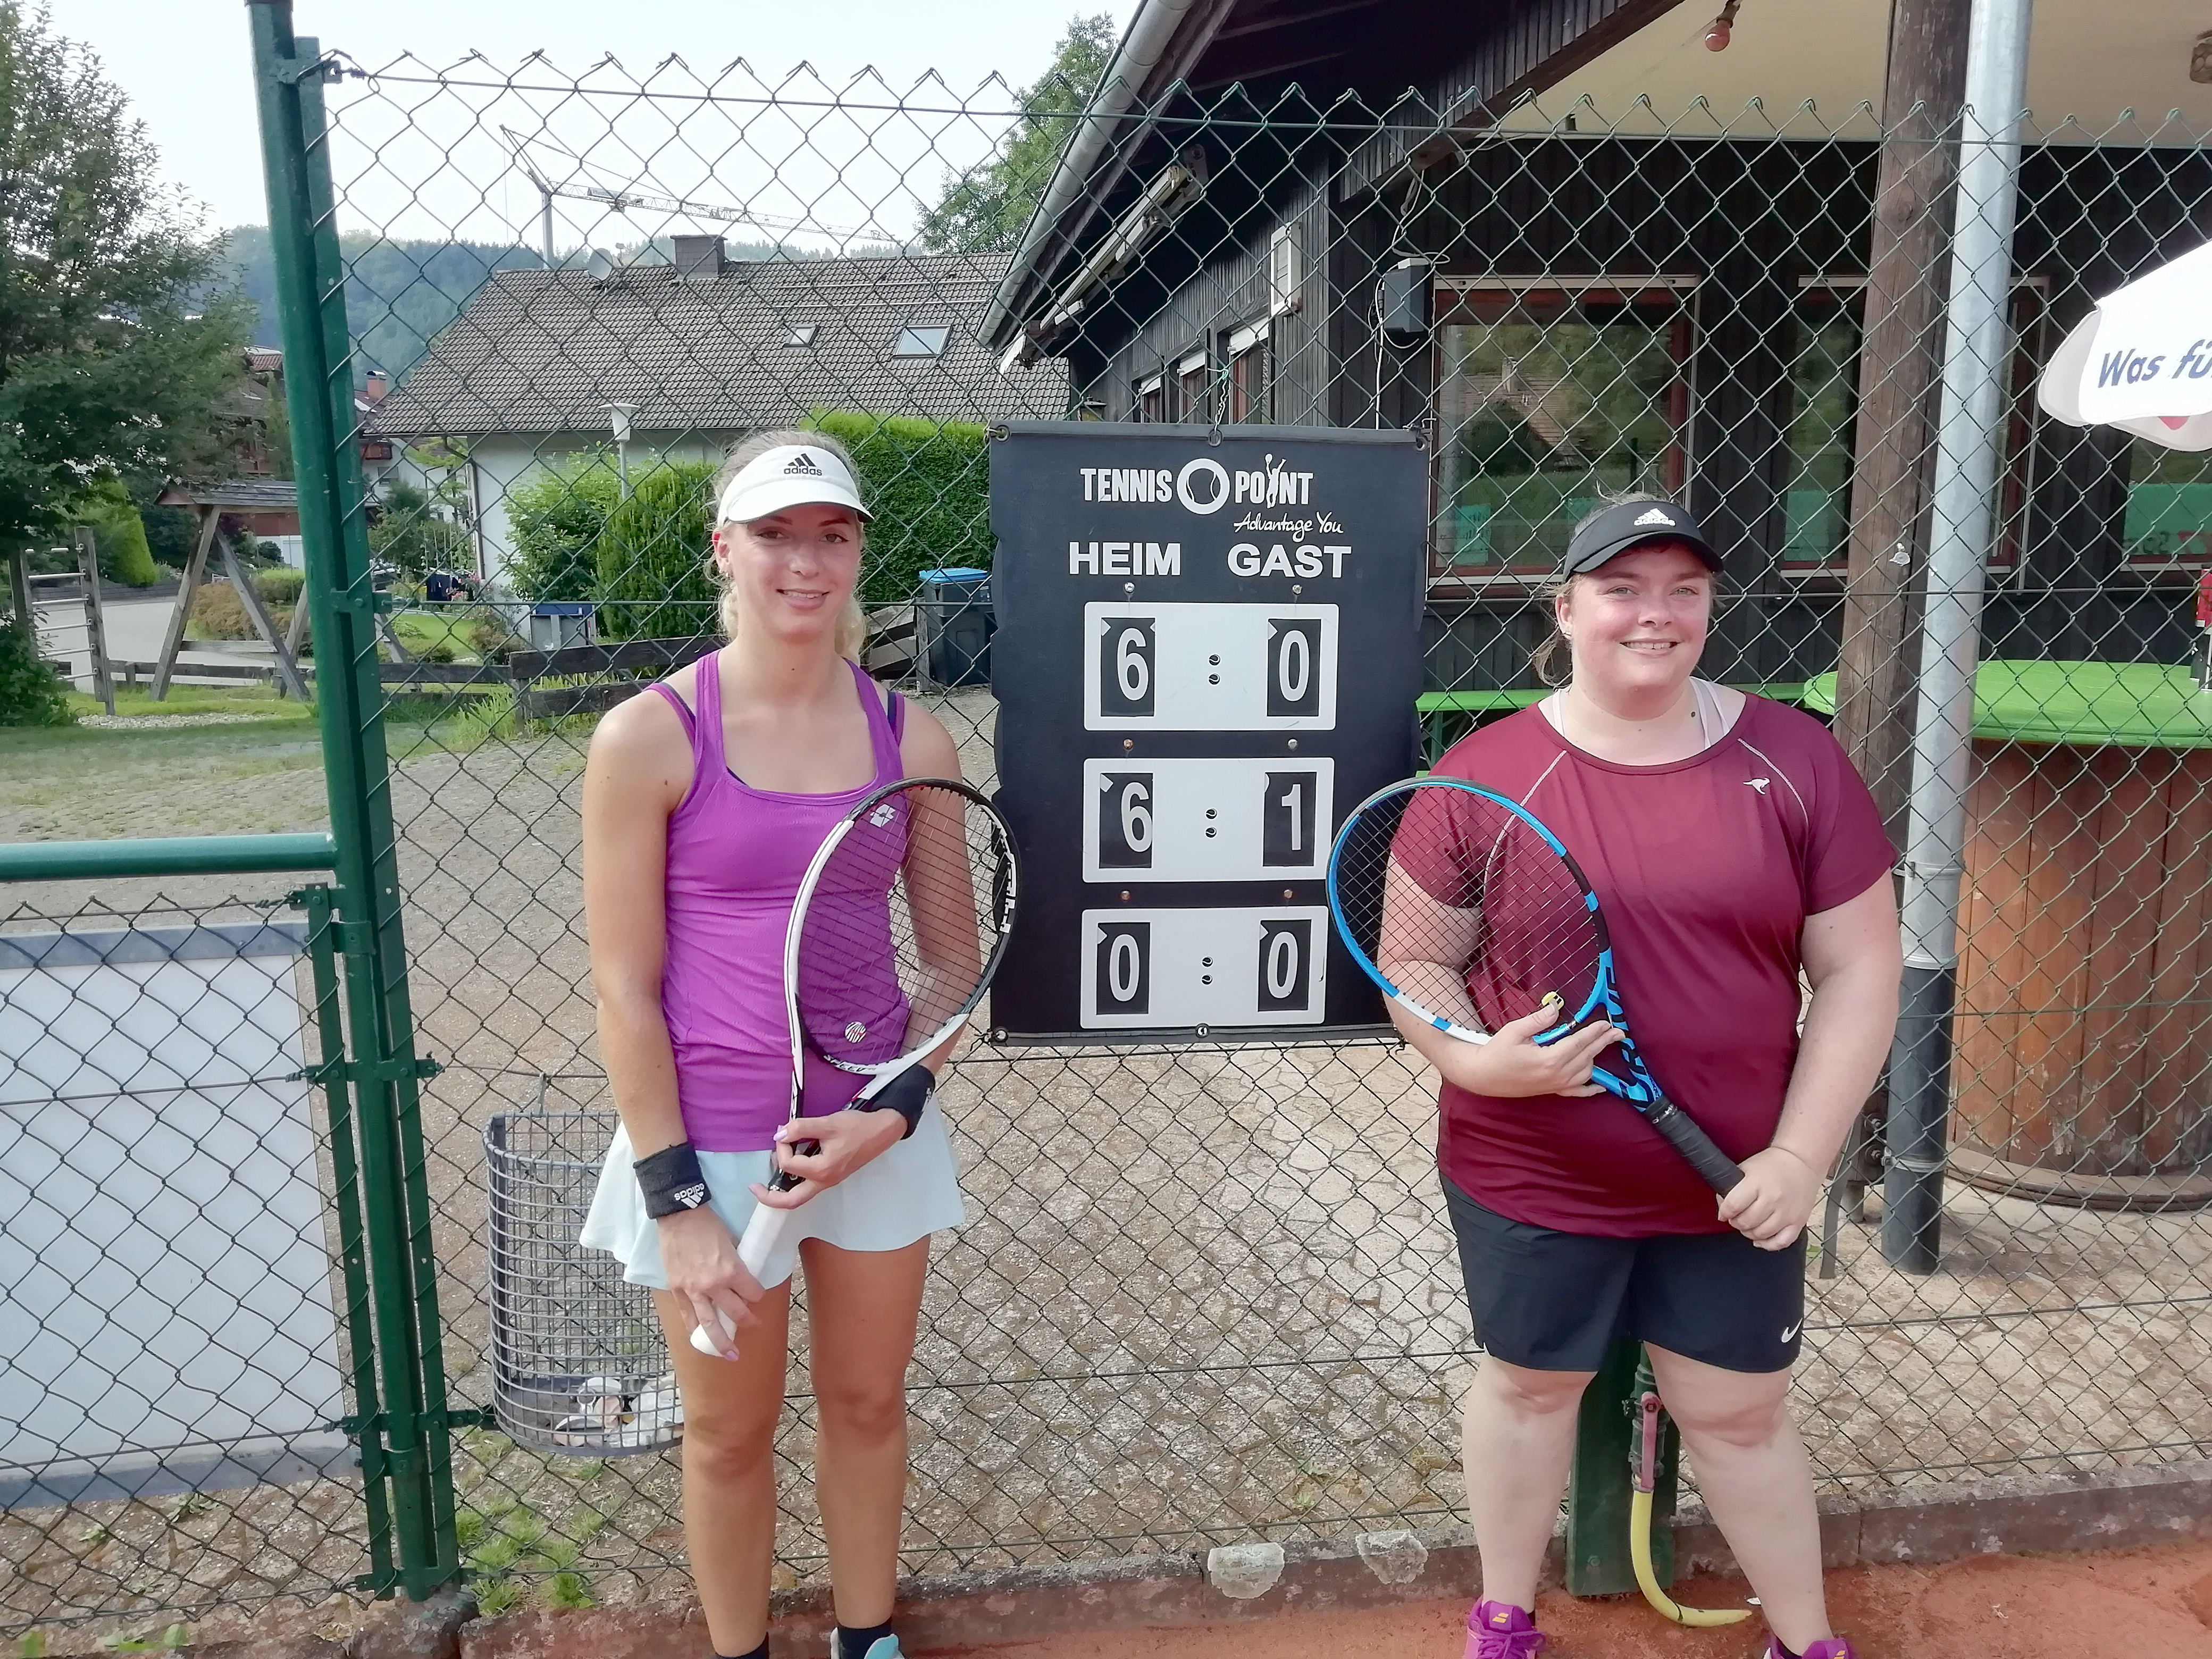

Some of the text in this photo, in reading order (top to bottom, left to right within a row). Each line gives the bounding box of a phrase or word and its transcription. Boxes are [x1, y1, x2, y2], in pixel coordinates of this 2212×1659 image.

[2098, 339, 2212, 388] Was fü
[783, 465, 823, 476] adidas
[1080, 468, 1174, 502] TENNIS
[1234, 512, 1344, 542] Advantage You
[1633, 518, 1676, 526] adidas
[1069, 541, 1352, 579] HEIM GAST
[1117, 627, 1310, 702] 6 0
[1120, 782, 1302, 852] 6 1
[1109, 931, 1298, 1002] 0 0
[674, 1183, 705, 1201] adidas
